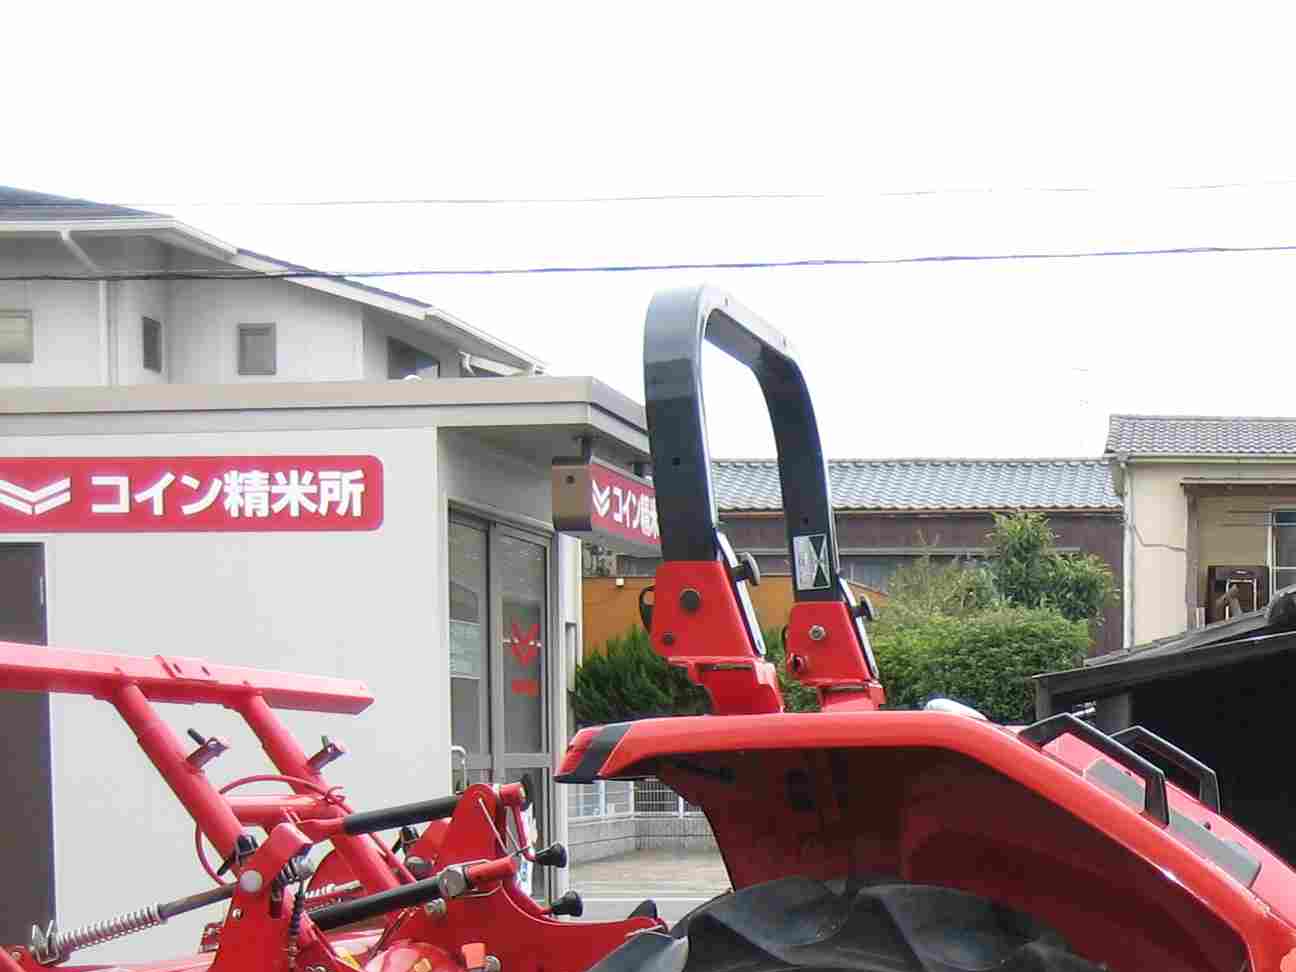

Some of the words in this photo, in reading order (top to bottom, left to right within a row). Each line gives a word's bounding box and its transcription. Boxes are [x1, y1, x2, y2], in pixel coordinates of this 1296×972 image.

[91, 468, 365, 518] コイン精米所
